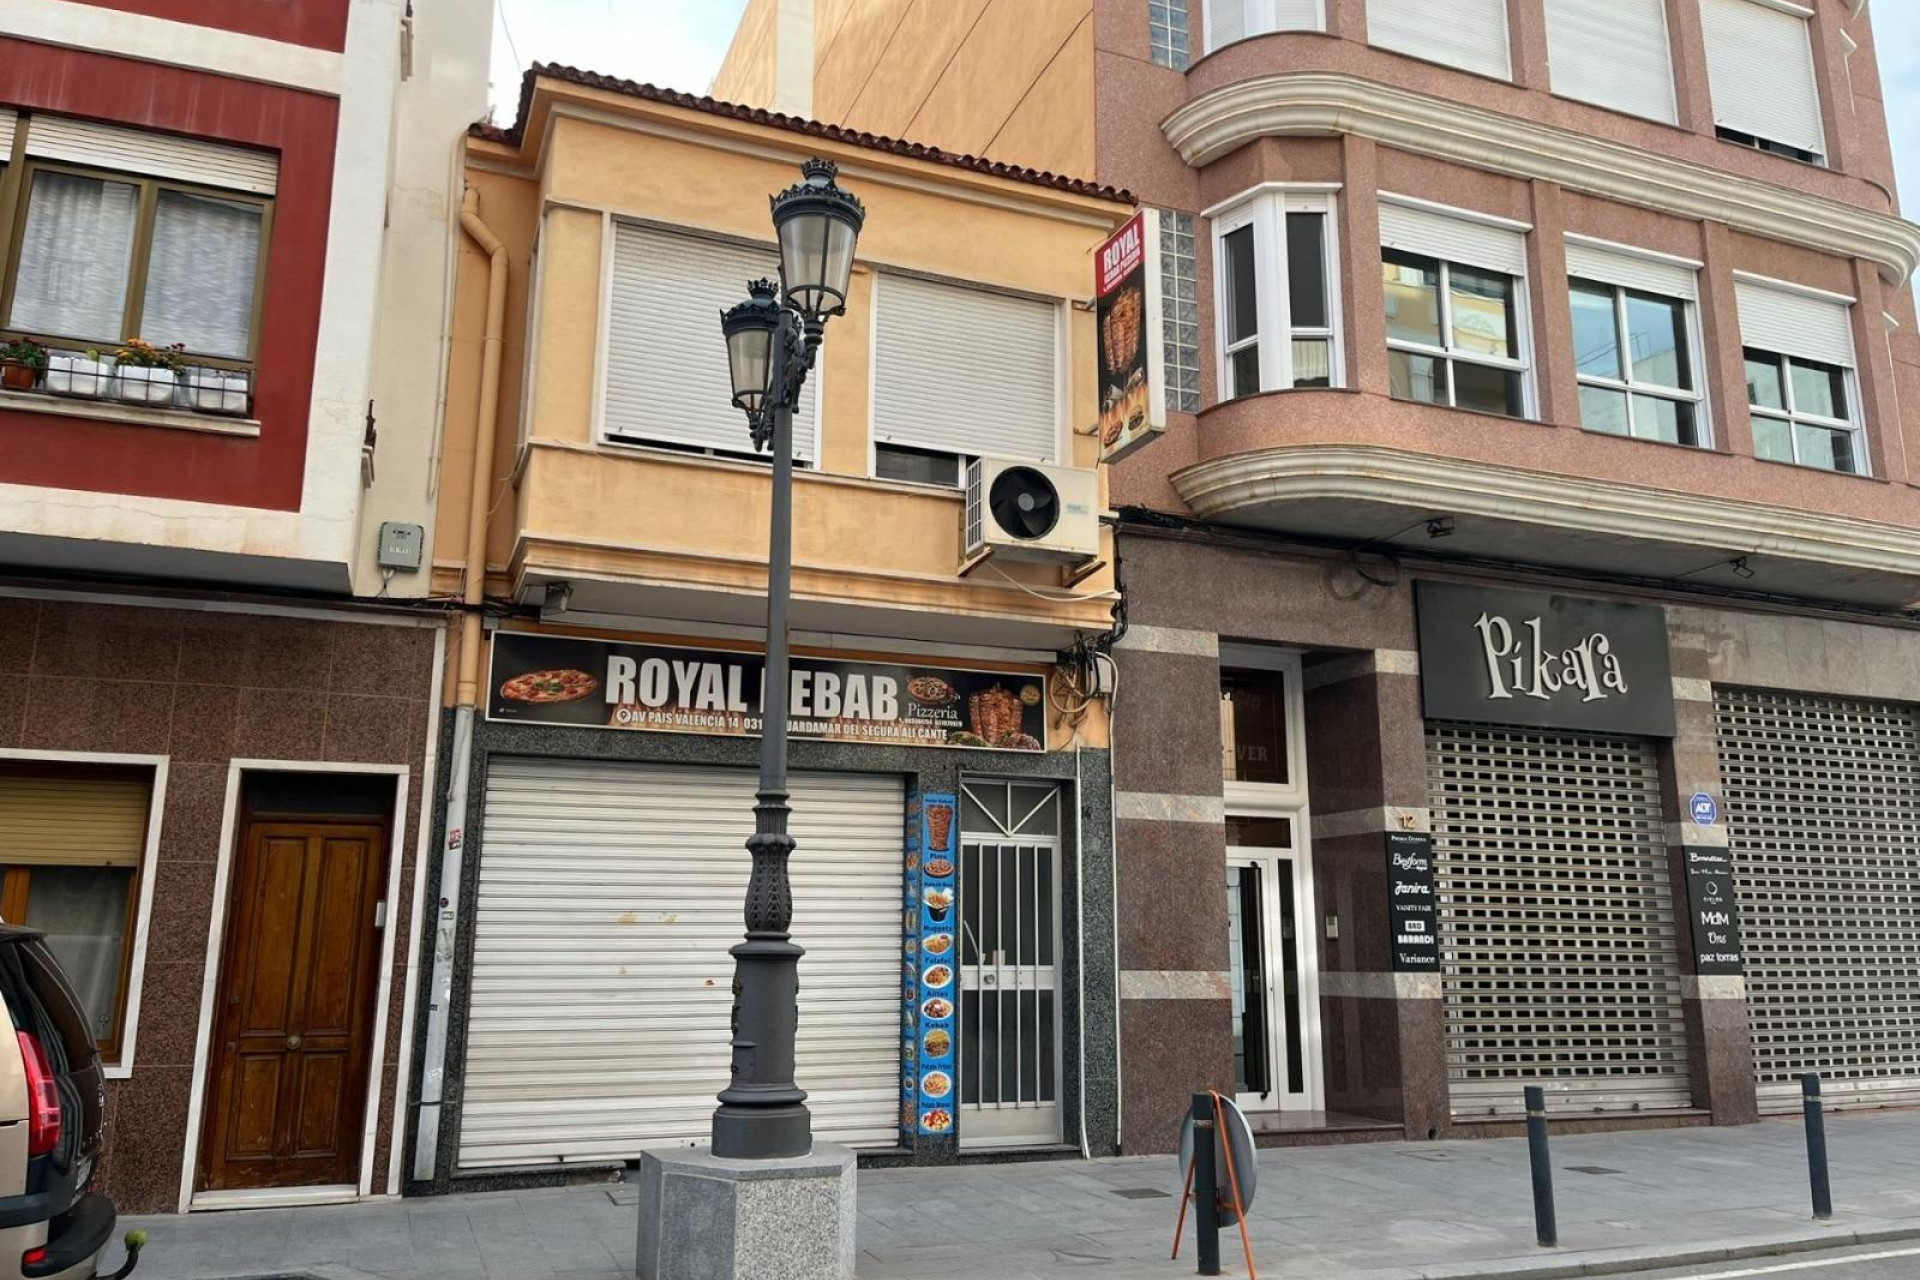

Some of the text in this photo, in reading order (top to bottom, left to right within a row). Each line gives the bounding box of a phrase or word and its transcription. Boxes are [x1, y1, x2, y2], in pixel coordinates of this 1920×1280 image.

[1103, 223, 1140, 275] ROYAL
[605, 655, 899, 721] ROYAL EBAB
[908, 702, 958, 720] Pizzeria
[632, 712, 646, 723] AV
[648, 713, 673, 725] PAIS
[675, 714, 726, 728] VALENCIA
[727, 717, 739, 728] 14
[786, 720, 841, 734] UARDAMAR
[843, 723, 861, 736] DEL
[862, 724, 900, 738] SEGURA
[1695, 802, 1712, 813] ADT
[1400, 813, 1417, 829] 12
[1394, 881, 1431, 895] Janira
[1395, 904, 1417, 912] VANITY
[923, 925, 952, 933] Nuggets
[1397, 934, 1435, 945] BARANDI
[1399, 952, 1436, 964] Variance
[1700, 953, 1715, 963] paz
